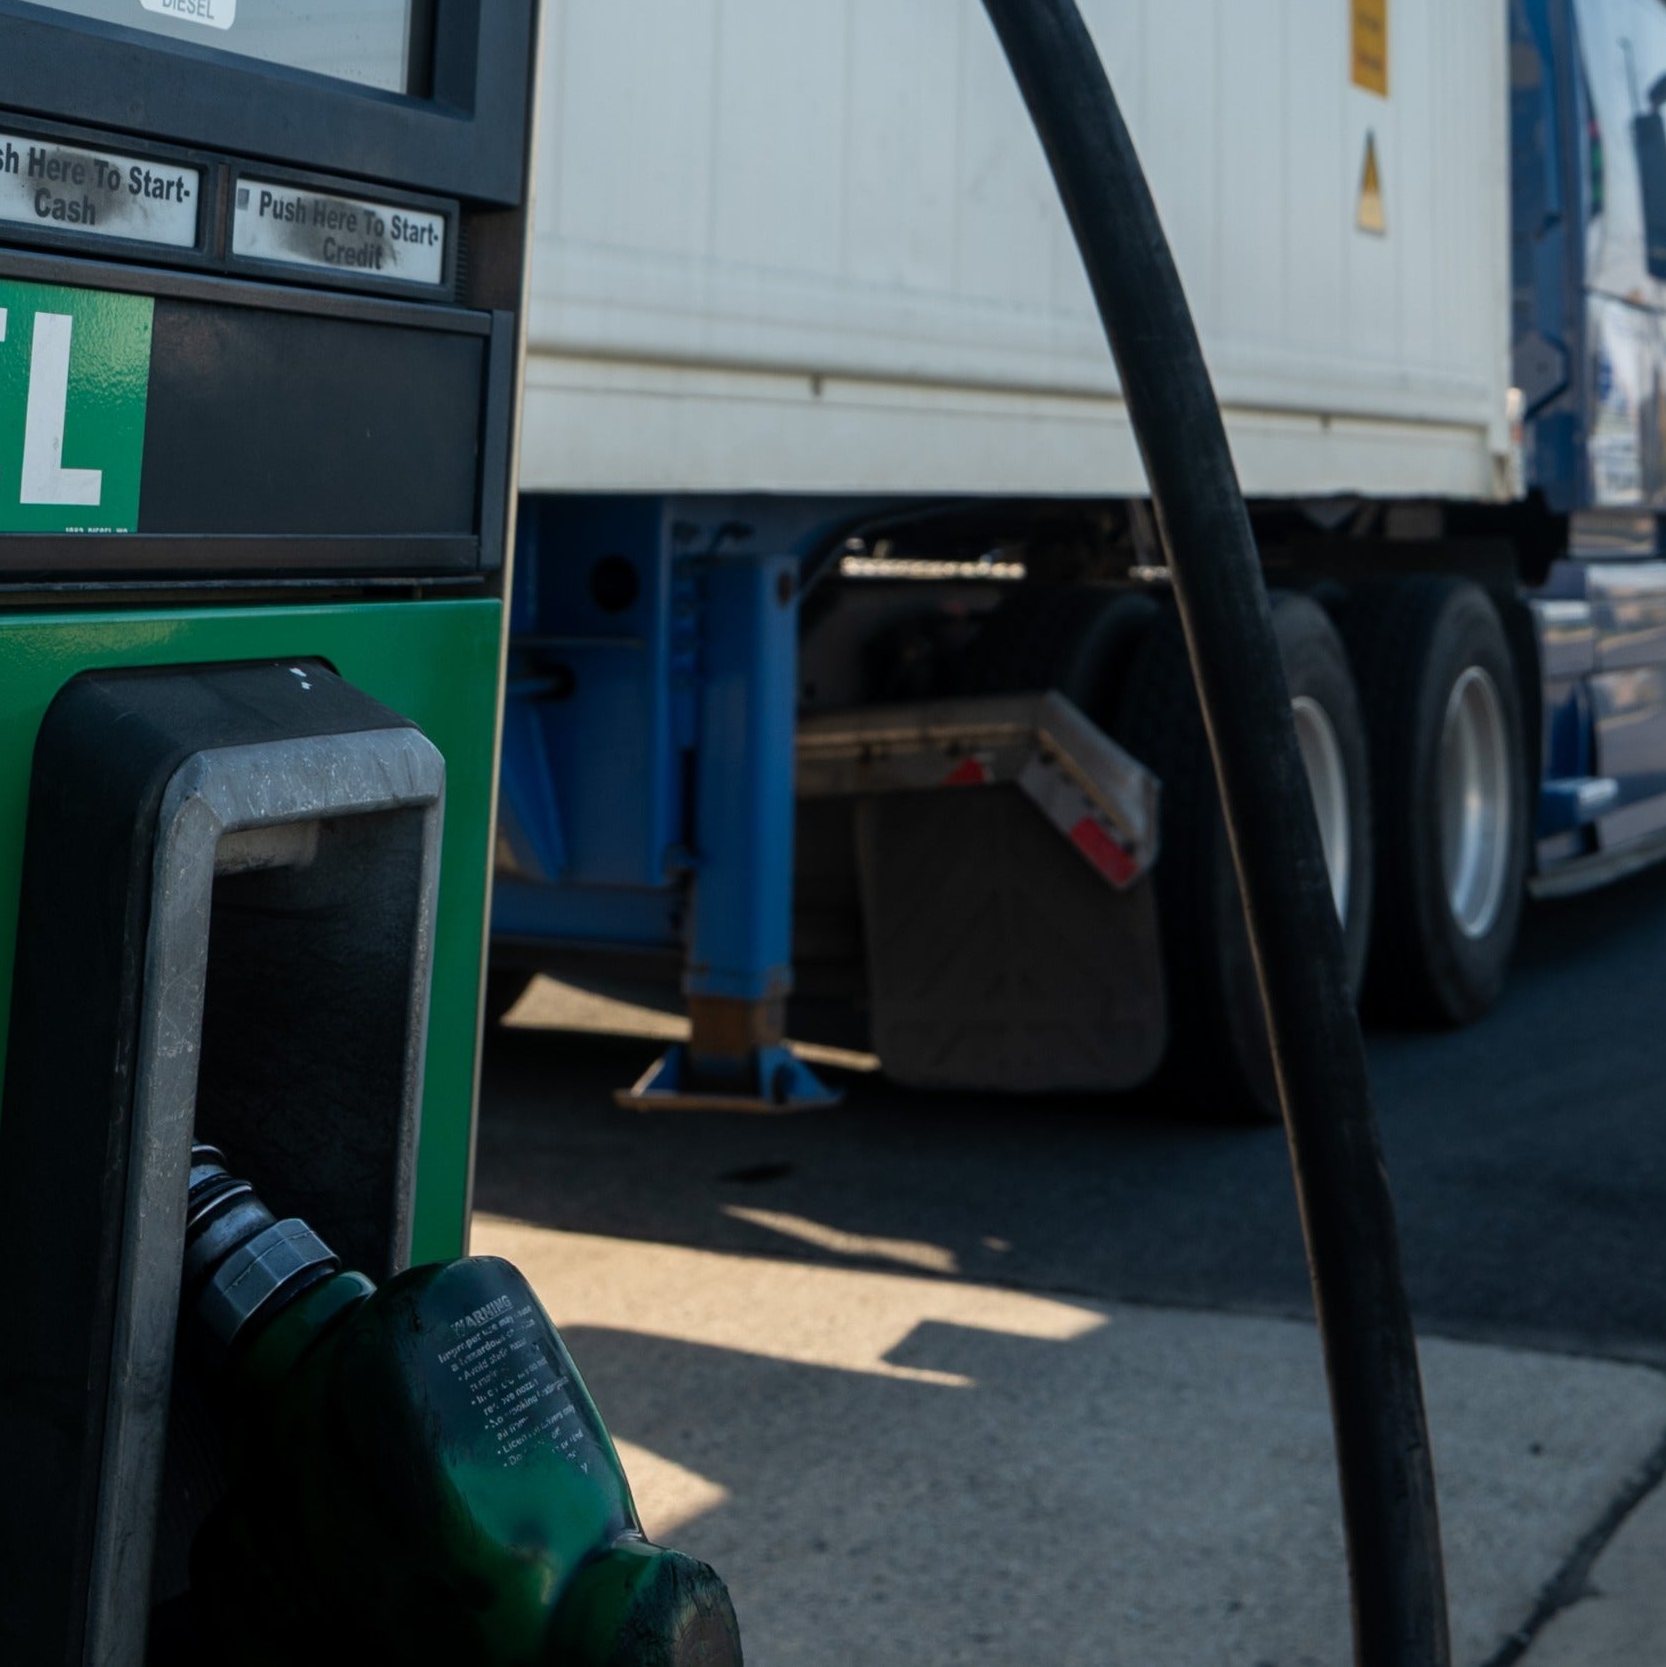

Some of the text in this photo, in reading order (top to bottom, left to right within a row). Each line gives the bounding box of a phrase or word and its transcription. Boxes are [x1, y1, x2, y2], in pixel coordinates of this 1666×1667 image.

[27, 147, 86, 185] Here
[94, 160, 121, 193] To
[127, 166, 192, 204] Start-
[33, 186, 96, 226] Cash
[258, 190, 440, 248] Push Here To Start-
[322, 236, 384, 272] Credit
